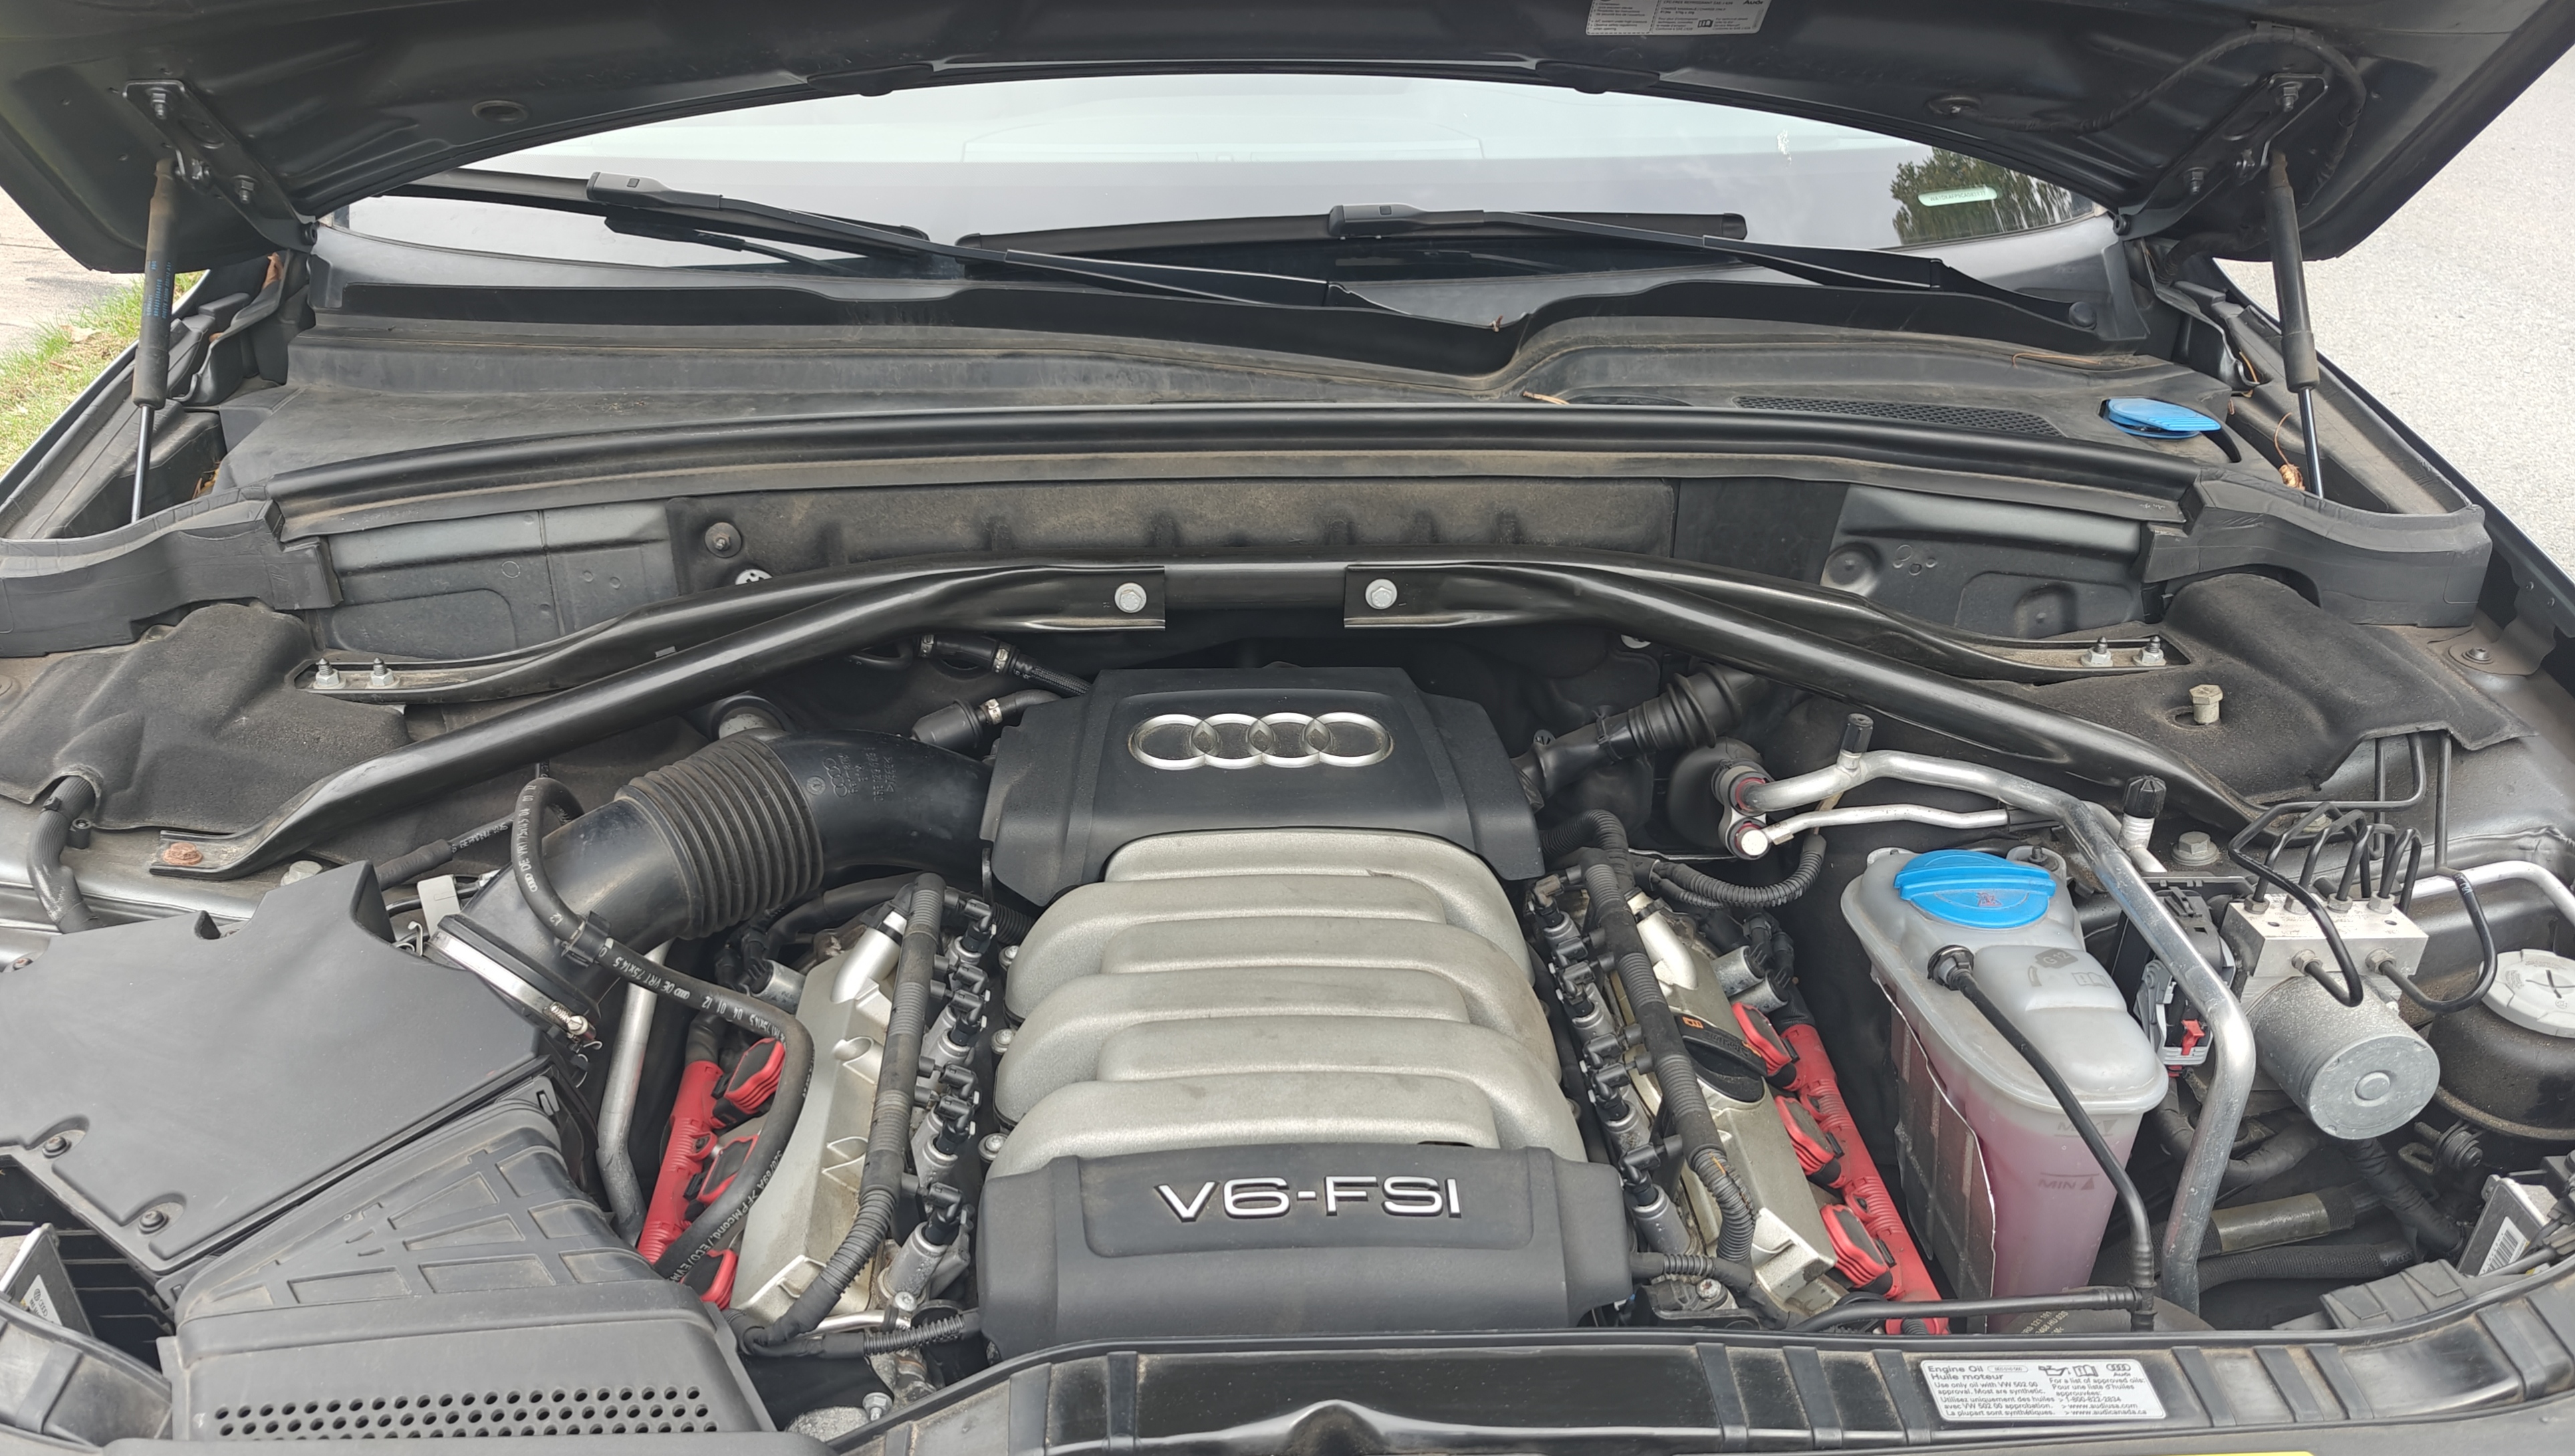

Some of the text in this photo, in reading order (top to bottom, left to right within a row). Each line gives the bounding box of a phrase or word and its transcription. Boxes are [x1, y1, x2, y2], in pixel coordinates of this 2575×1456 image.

[644, 973, 661, 989] VRT
[702, 995, 713, 1009] 12
[717, 999, 727, 1015] 01
[2037, 1179, 2077, 1190] MIN
[1154, 1175, 1462, 1223] V6-FSI
[2047, 1318, 2058, 1326] HU
[1928, 1366, 1965, 1374] Engine
